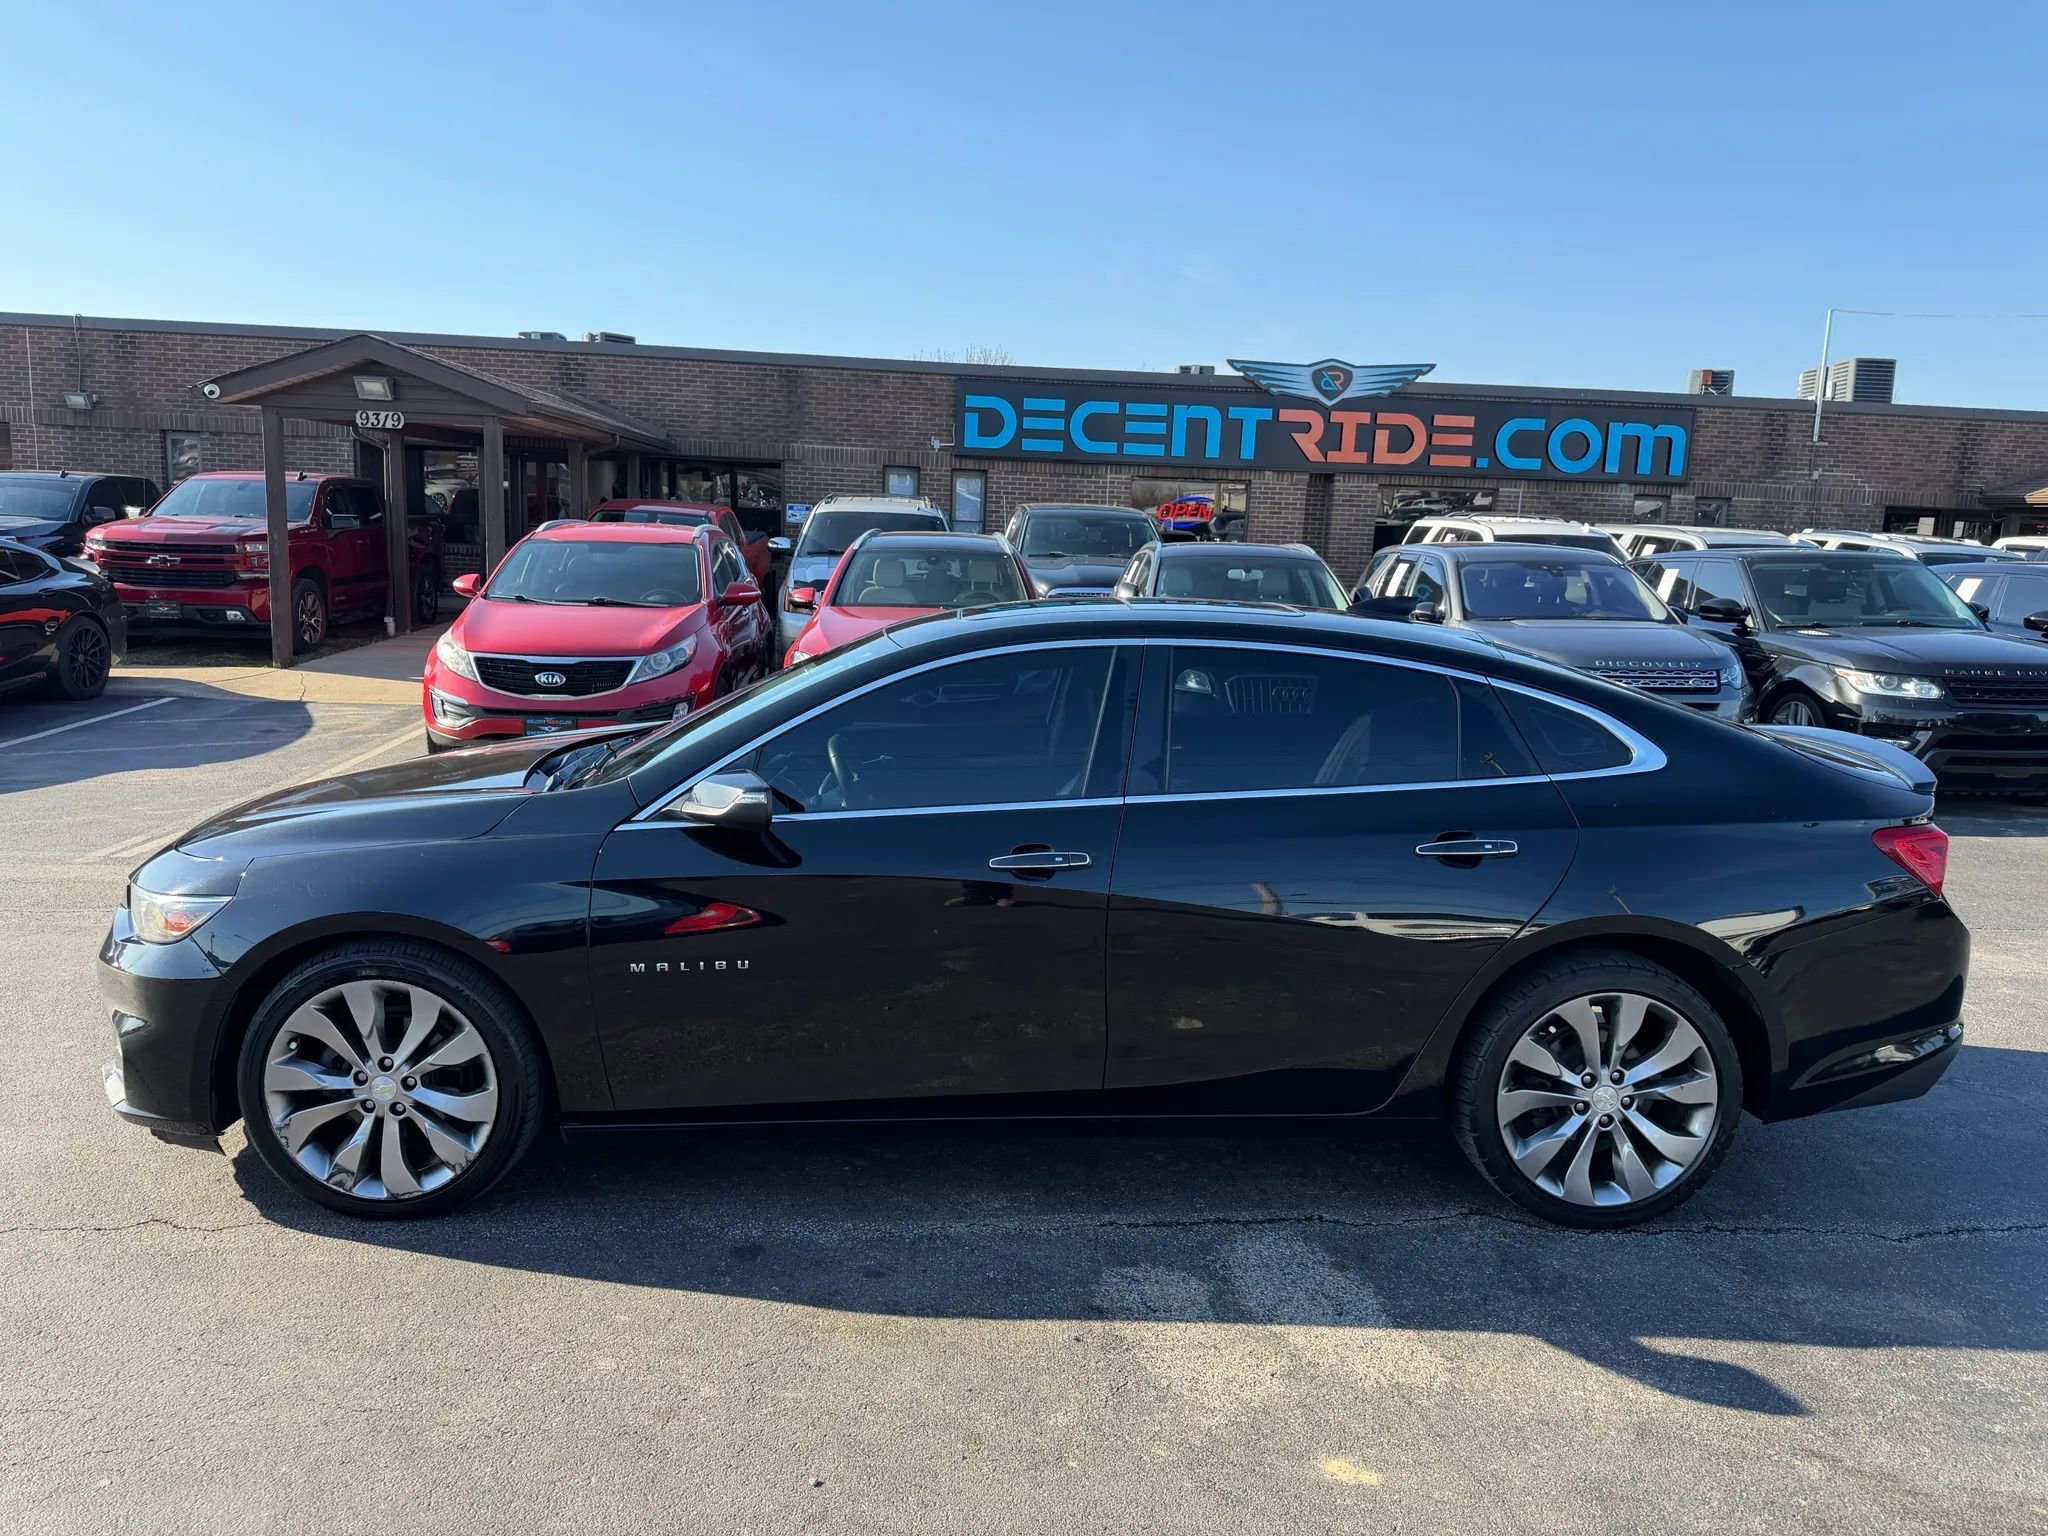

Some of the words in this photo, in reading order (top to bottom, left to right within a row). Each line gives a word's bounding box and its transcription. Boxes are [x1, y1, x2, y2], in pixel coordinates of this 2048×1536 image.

[359, 411, 402, 428] 9319
[1156, 502, 1215, 523] OPEN
[1595, 660, 1701, 669] DISCOVERY
[1945, 668, 2007, 677] RANGE
[540, 674, 561, 684] KIA
[629, 960, 749, 973] MALIBU
